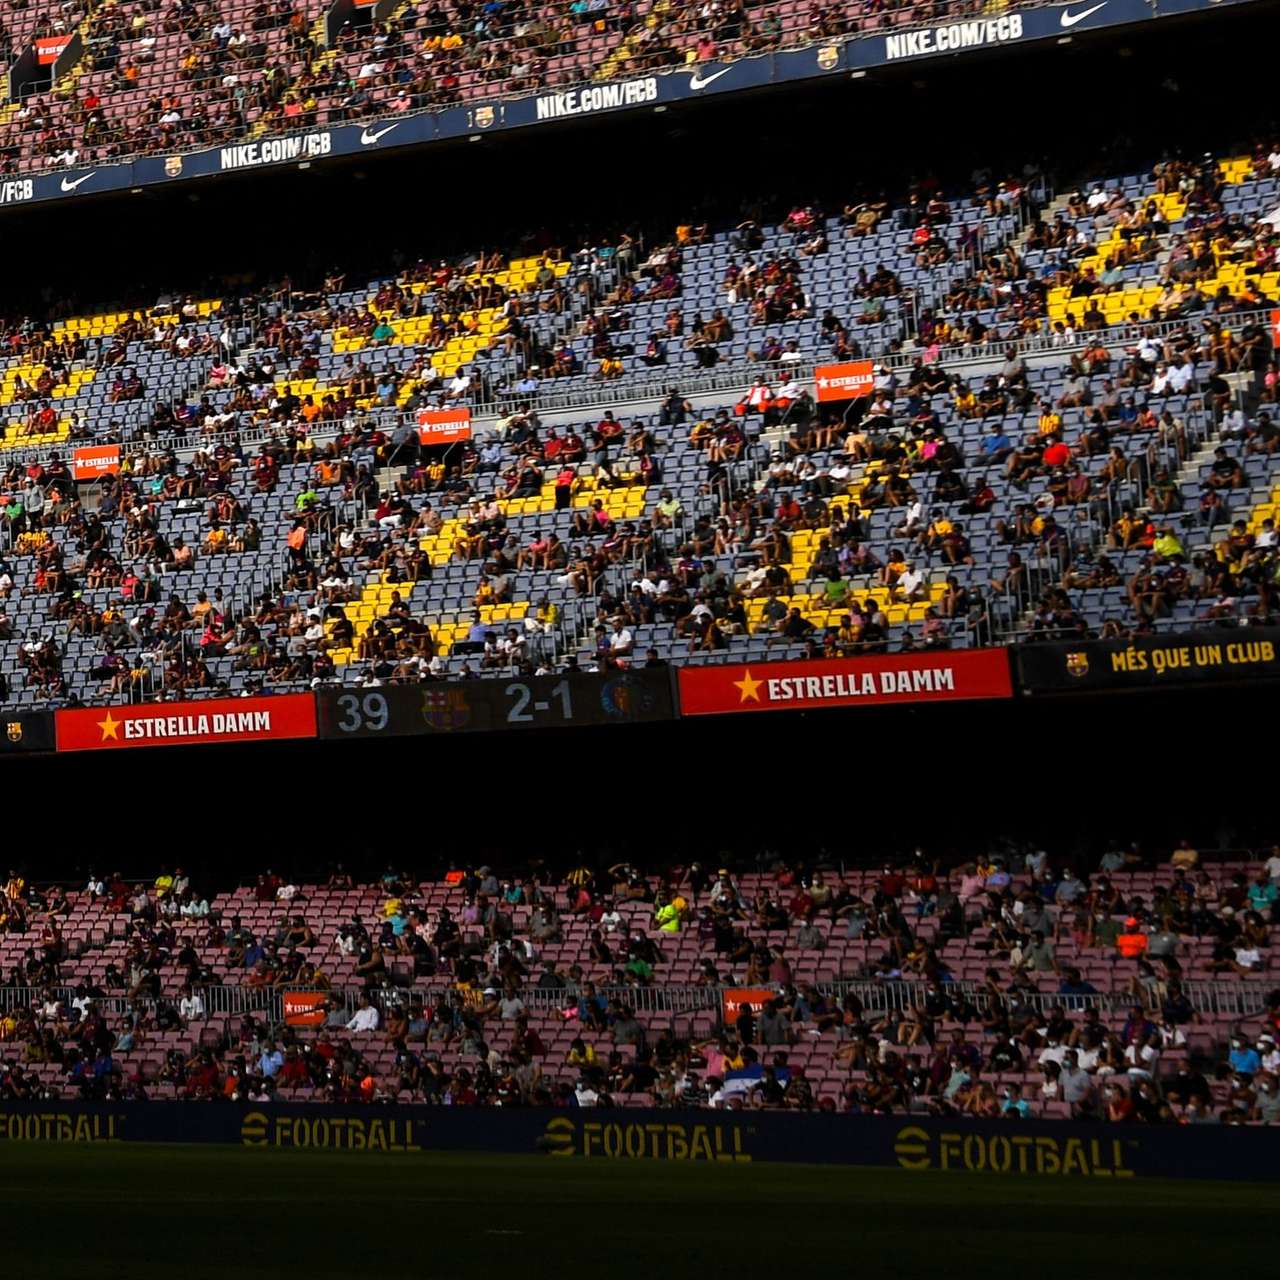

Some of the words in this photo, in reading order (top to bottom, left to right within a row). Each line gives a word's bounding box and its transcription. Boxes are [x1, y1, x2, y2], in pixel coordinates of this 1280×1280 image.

[432, 421, 470, 432] ESTRELLA
[84, 456, 120, 467] ESTRELLA
[1111, 646, 1149, 672] MÉS
[1152, 647, 1191, 674] QUE
[1194, 644, 1223, 666] UN
[1226, 640, 1276, 663] CLUB
[768, 671, 877, 701] ESTRELLA
[881, 667, 954, 695] DAMM
[338, 692, 389, 732] 39
[505, 679, 573, 723] 2-1
[124, 714, 209, 739] ESTRELLA
[212, 711, 271, 736] DAMM
